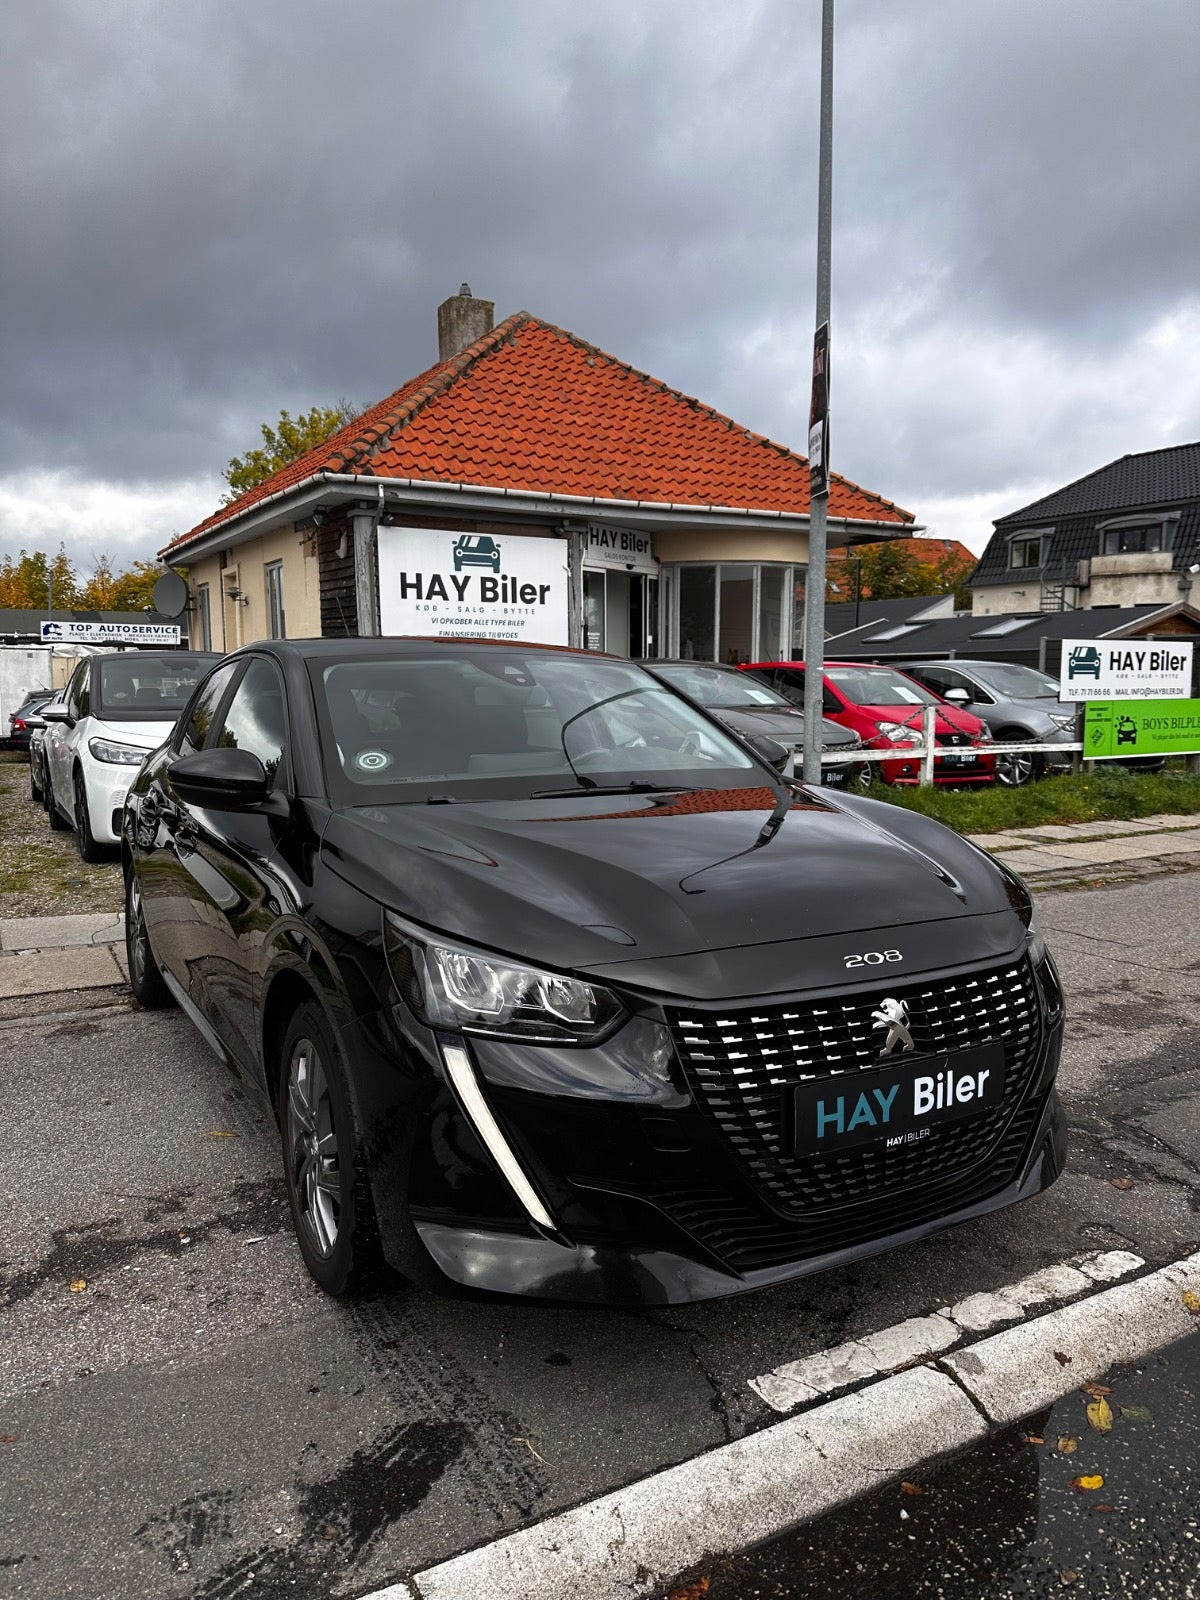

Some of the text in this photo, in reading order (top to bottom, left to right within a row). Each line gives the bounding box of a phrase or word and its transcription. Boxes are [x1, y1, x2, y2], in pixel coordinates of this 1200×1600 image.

[590, 527, 649, 554] HAY Biler
[400, 572, 551, 605] HAY Biler
[415, 604, 438, 612] KØB
[457, 606, 485, 614] SALG
[503, 607, 536, 615] BYTTE
[490, 619, 506, 627] TYPE
[69, 624, 178, 635] TOP AUTOSERVICE
[488, 631, 519, 639] TILBYDES
[1109, 650, 1187, 671] HAY Biler
[1142, 718, 1169, 730] BOYS
[827, 773, 844, 781] Biler
[844, 949, 903, 968] 208
[816, 1068, 990, 1138] HAY Biler
